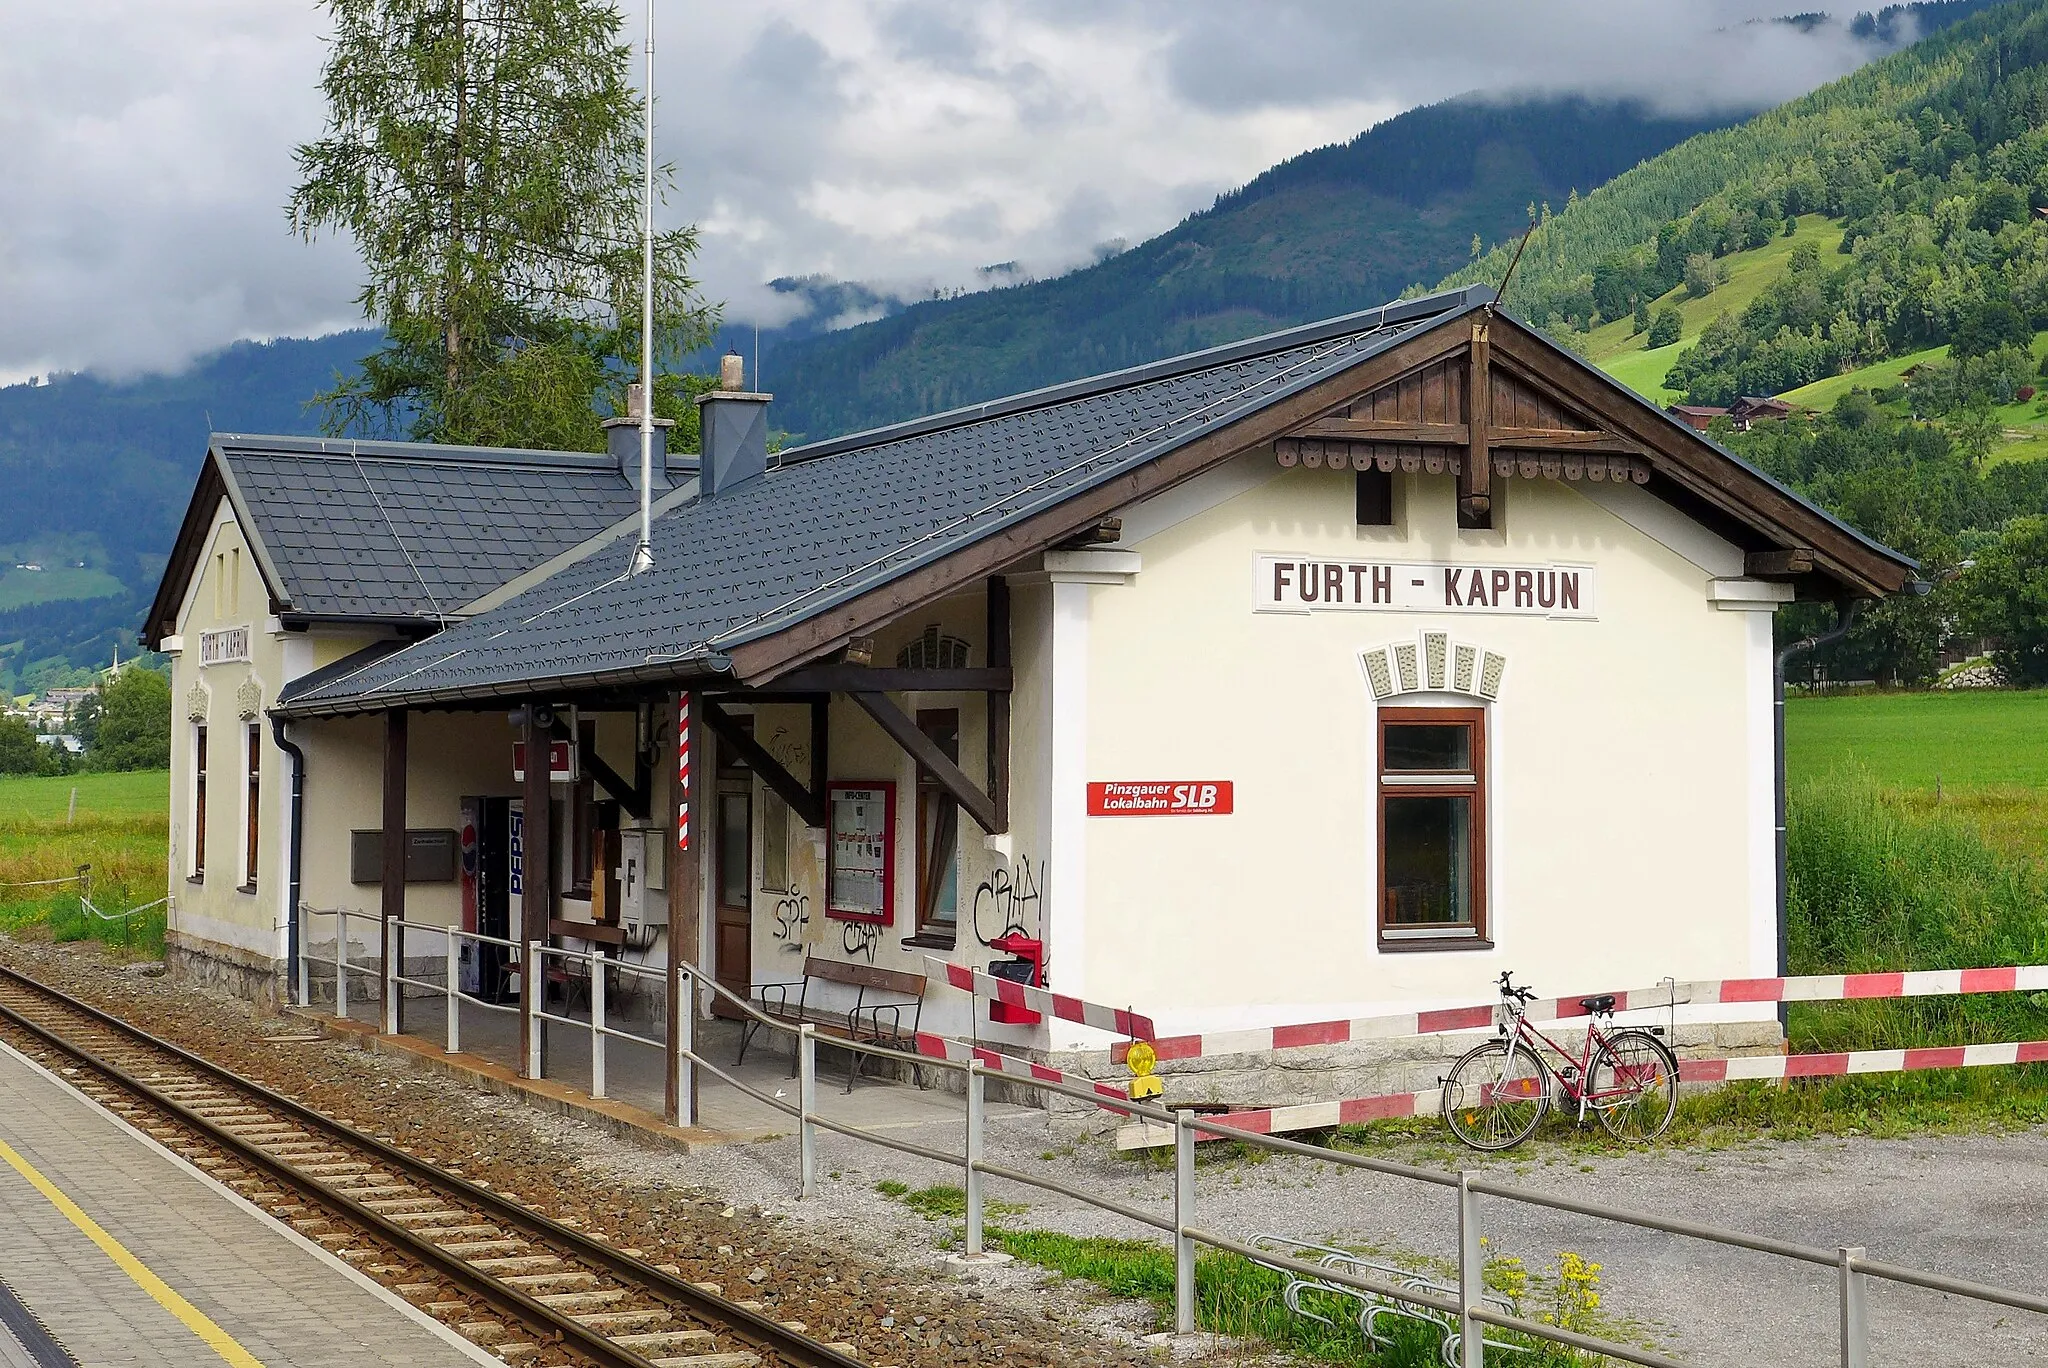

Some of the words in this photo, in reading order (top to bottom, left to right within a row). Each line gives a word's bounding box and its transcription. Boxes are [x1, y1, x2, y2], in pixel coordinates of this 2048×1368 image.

[1274, 562, 1391, 604] FÜRTH
[1445, 568, 1579, 609] KAPRUN
[1104, 783, 1171, 797] Pinzgauer
[1171, 784, 1218, 808] SLB
[1103, 797, 1168, 809] Lokalbahn
